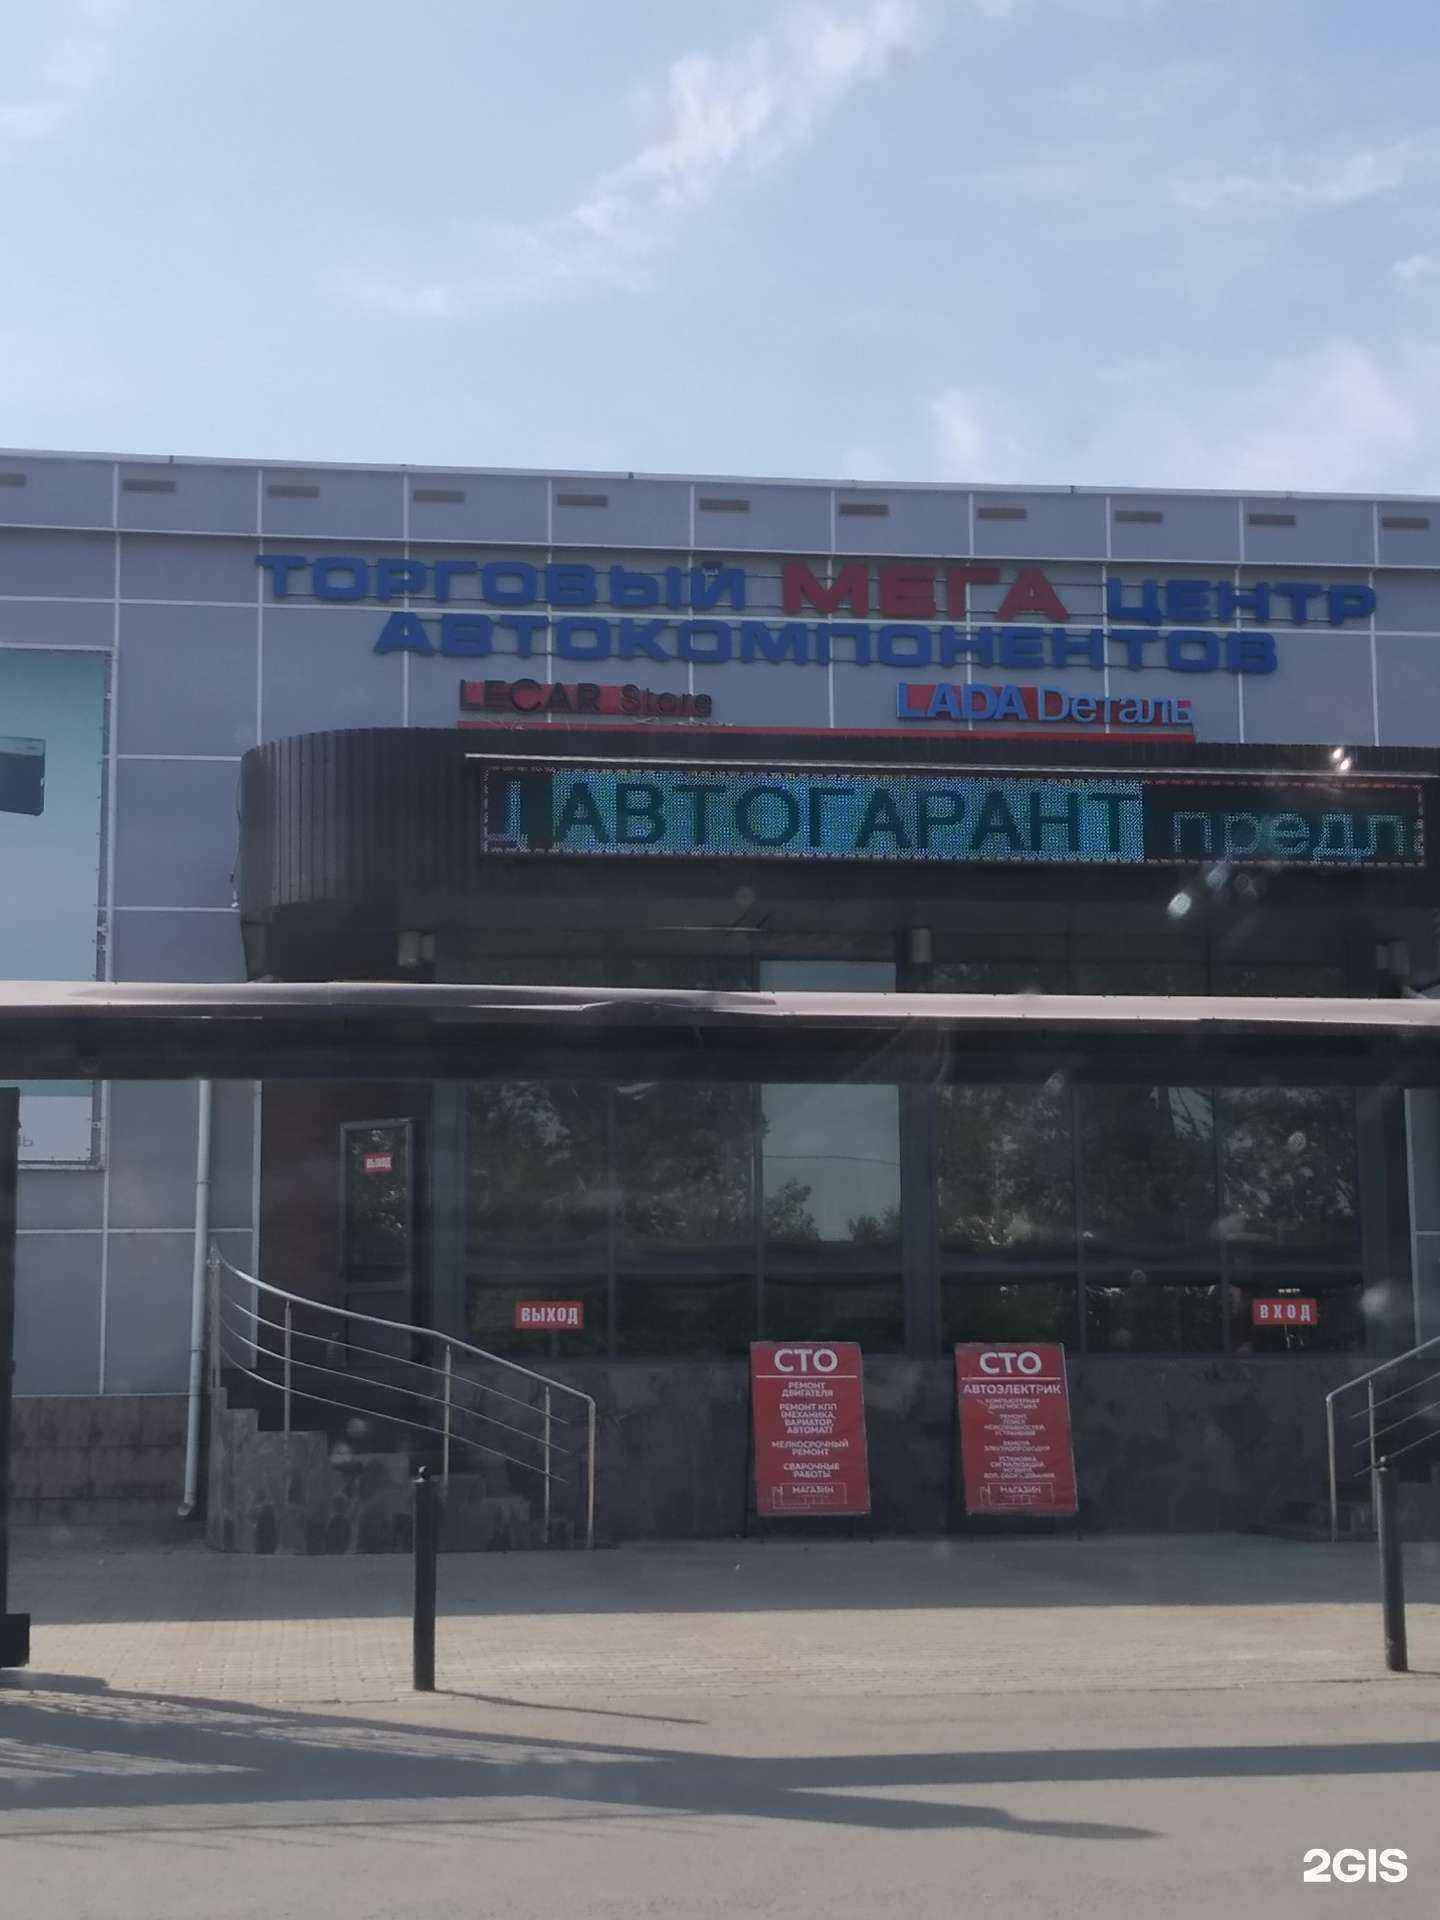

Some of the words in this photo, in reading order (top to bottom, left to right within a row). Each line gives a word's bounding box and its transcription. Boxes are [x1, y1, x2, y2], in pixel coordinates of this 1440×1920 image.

[255, 554, 746, 610] ТОРГОВЫЙ
[782, 562, 1069, 621] МЕГА
[1104, 577, 1377, 627] ЦЕНТР
[373, 612, 1278, 674] АВТОКОМПОНЕНТОВ
[896, 682, 1030, 721] LADA
[559, 780, 1142, 856] АВТОГАРАНТ
[520, 1307, 579, 1325] ВЫХОД
[1259, 1304, 1312, 1322] ВХОД
[774, 1349, 839, 1373] СТО
[979, 1351, 1042, 1375] СТО
[962, 1383, 1062, 1395] АВТОЭЛЕКТРИК
